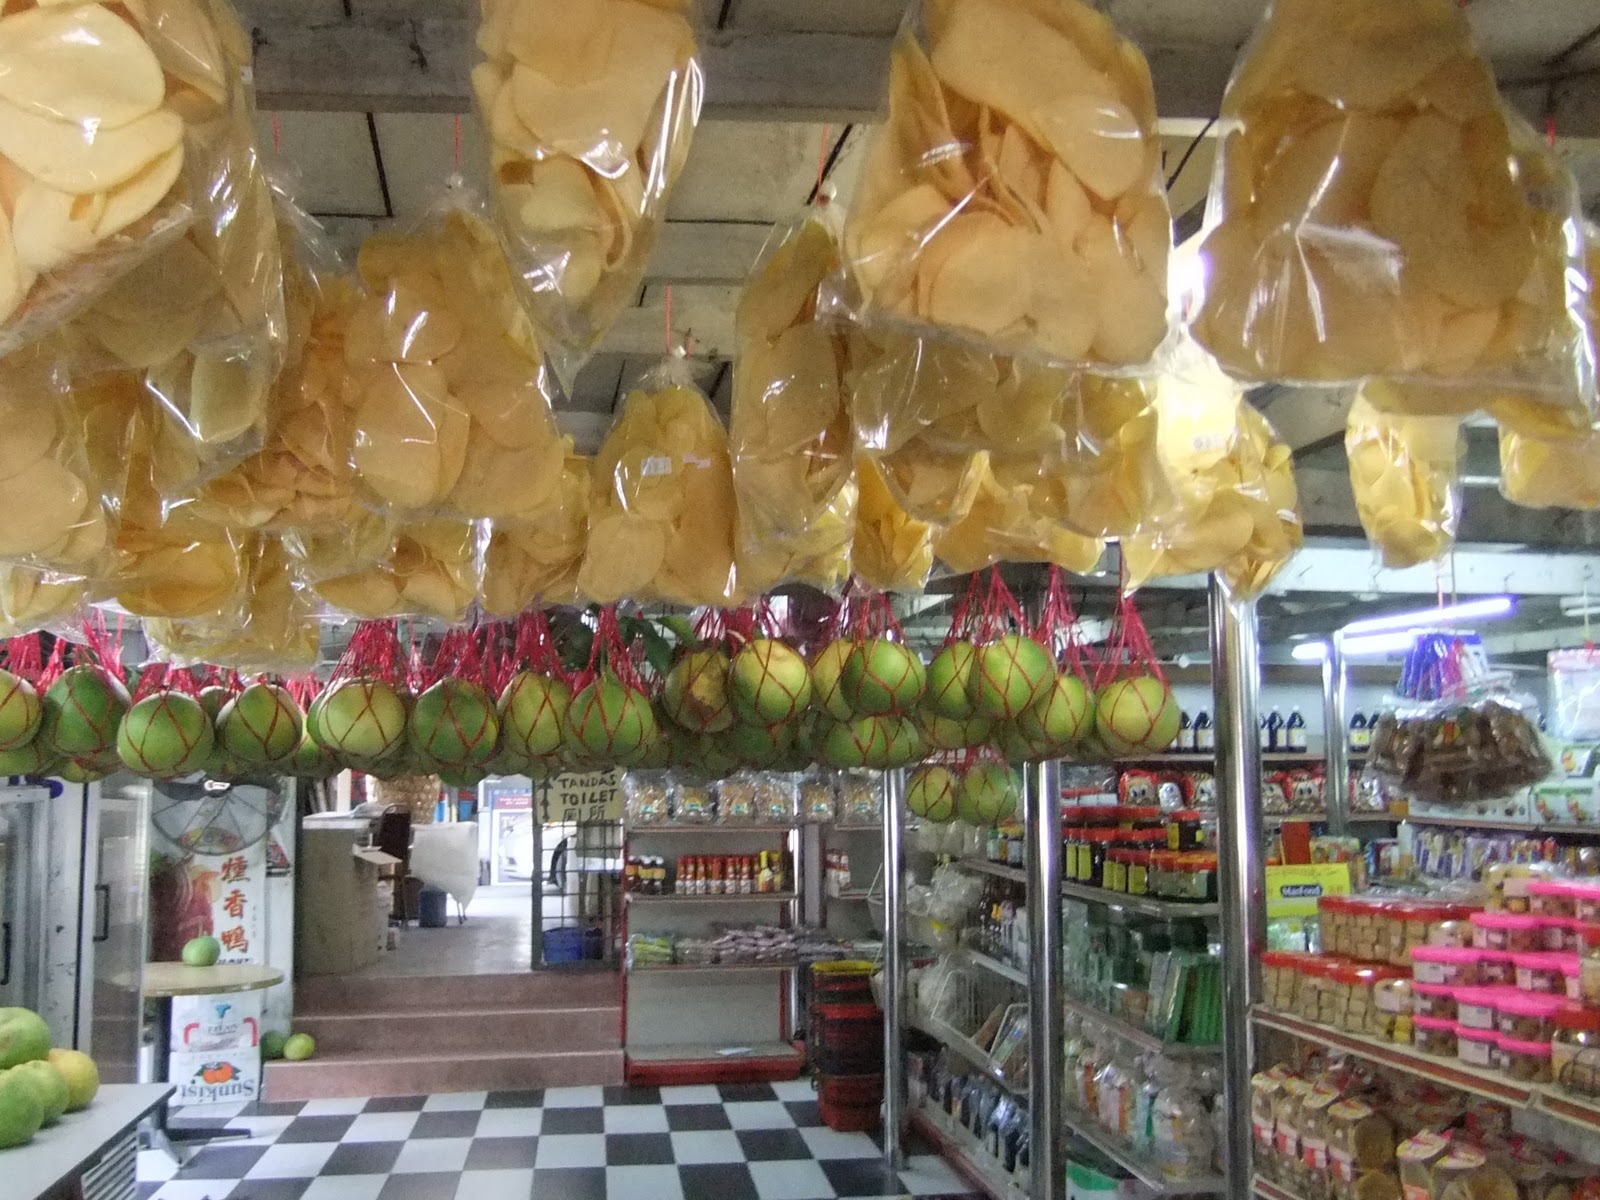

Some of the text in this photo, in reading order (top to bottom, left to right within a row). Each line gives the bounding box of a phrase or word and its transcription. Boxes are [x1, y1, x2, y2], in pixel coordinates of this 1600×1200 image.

[560, 774, 616, 789] TANDAS
[560, 789, 618, 806] TOILET
[181, 1079, 255, 1102] Sunkist
